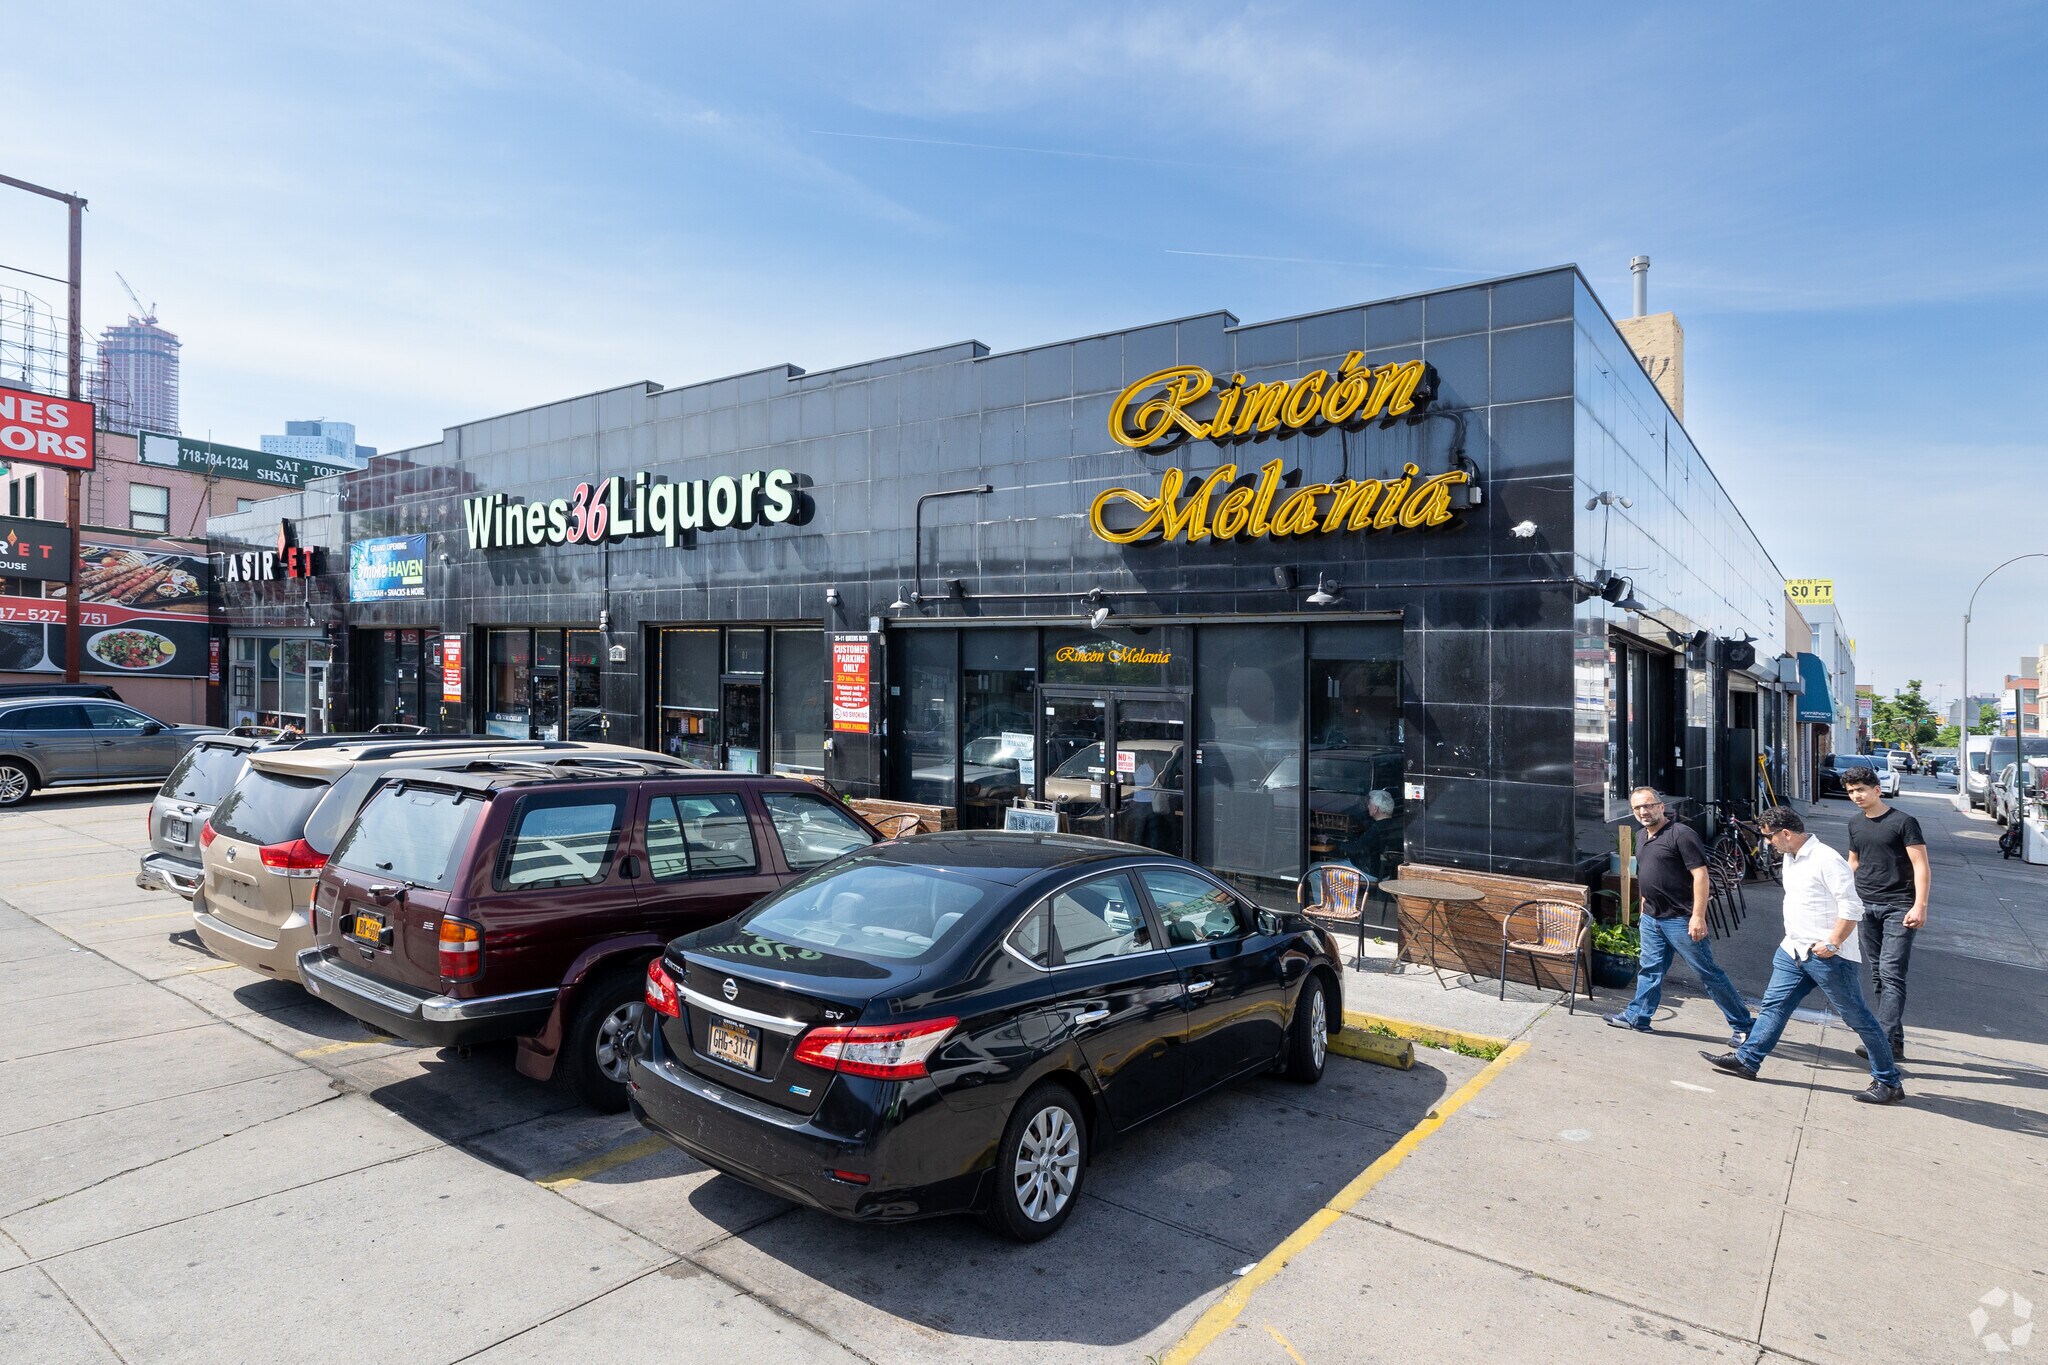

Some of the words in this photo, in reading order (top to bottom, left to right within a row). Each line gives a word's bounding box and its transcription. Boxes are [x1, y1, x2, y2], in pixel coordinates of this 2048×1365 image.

[1108, 351, 1425, 448] Rincón
[0, 396, 69, 428] NES
[0, 426, 87, 460] ORS
[182, 449, 249, 471] 718-784-1234
[276, 459, 300, 473] SAT
[312, 465, 348, 478] TOEF
[257, 469, 298, 485] SHSAT
[1089, 458, 1469, 544] Melania
[464, 493, 569, 550] Wines
[567, 478, 610, 543] 36
[609, 470, 794, 548] Liquors
[388, 559, 423, 577] HAVEN
[1791, 586, 1808, 598] SQ
[1814, 585, 1832, 597] FT
[834, 645, 868, 654] CUSTOMER
[1108, 647, 1172, 664] Melania
[837, 654, 866, 663] PARKING
[842, 663, 860, 673] ONLY
[848, 711, 868, 719] SMOKING
[1118, 753, 1127, 761] NO
[825, 1009, 845, 1020] SV
[713, 1028, 729, 1051] GHG
[733, 1035, 755, 1060] 3147
